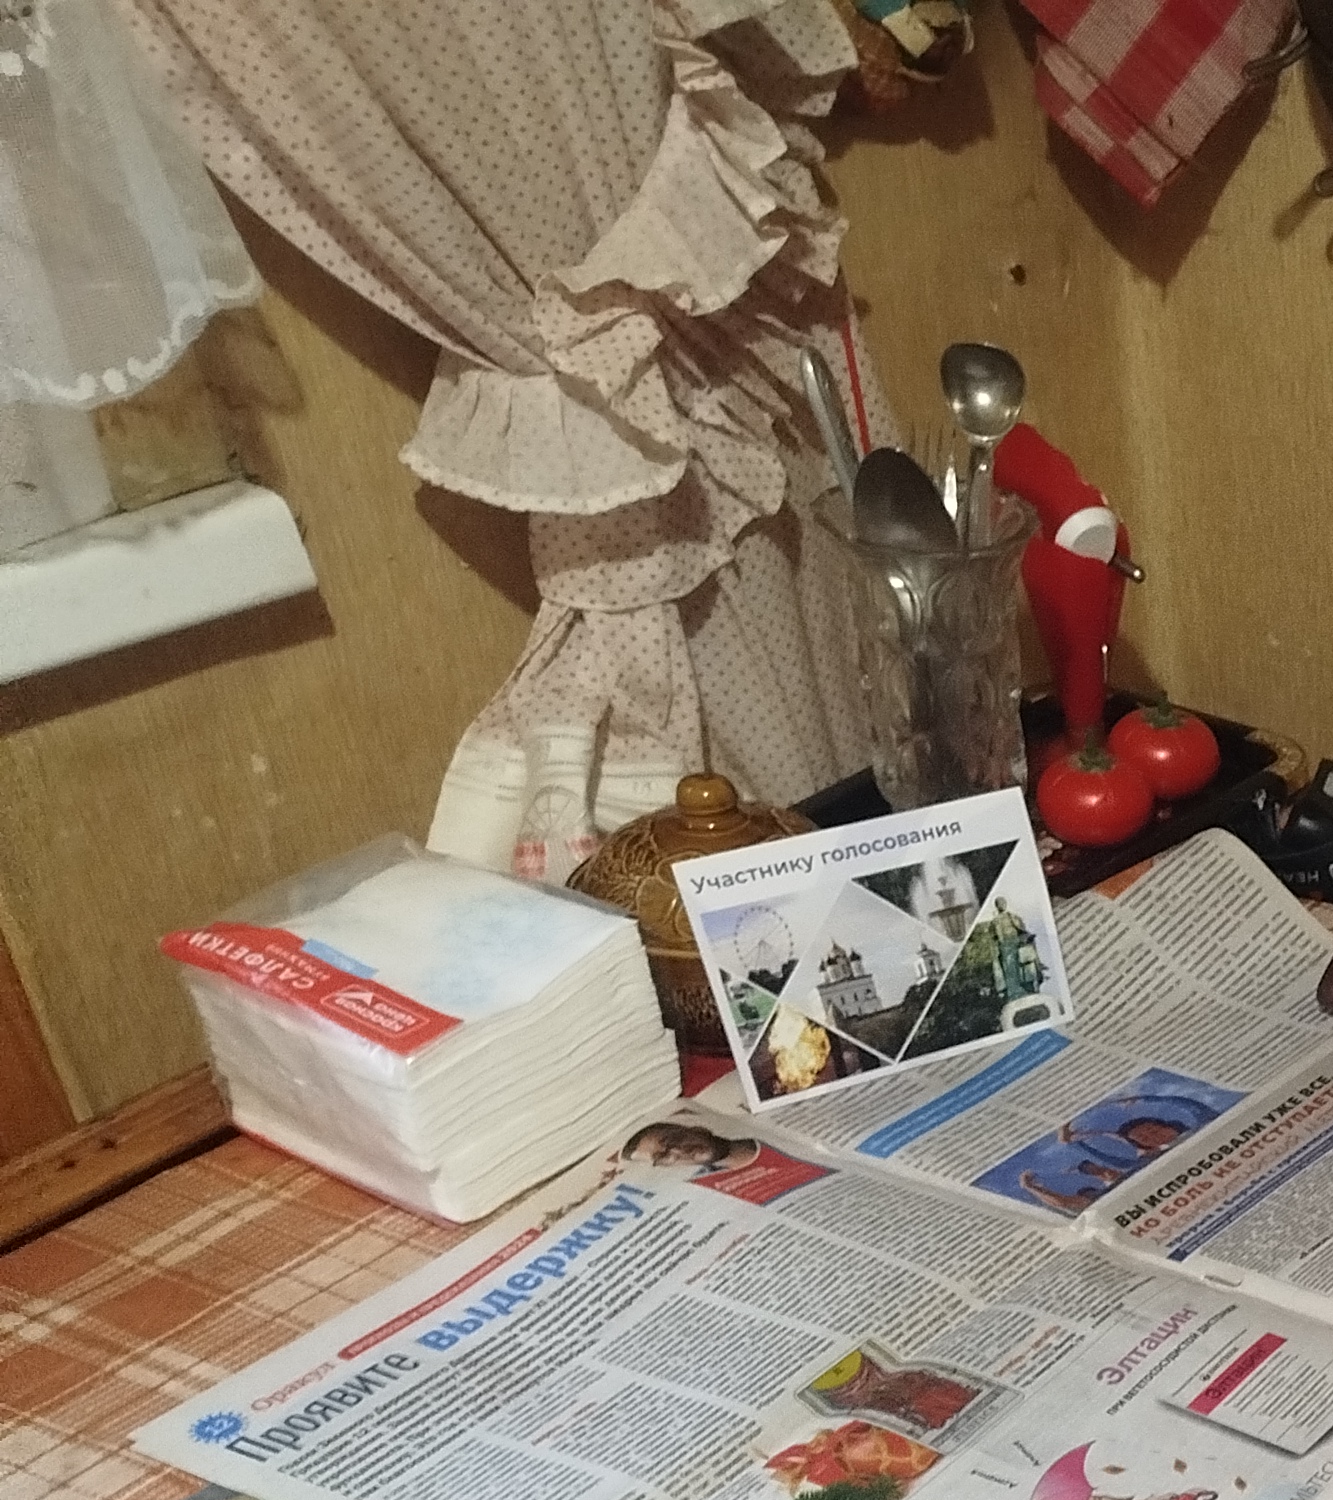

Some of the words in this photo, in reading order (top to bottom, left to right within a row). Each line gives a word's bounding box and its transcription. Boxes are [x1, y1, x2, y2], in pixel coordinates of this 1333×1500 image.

[690, 851, 814, 895] Участнику
[821, 819, 963, 868] голосования
[189, 932, 314, 989] САЛФЕТКИ
[1114, 1204, 1146, 1228] ВЫ
[1144, 1122, 1266, 1207] ИСПРОБОВАЛИ
[1262, 1095, 1302, 1123] УЖЕ
[1129, 1218, 1159, 1239] НО
[1161, 1180, 1214, 1217] БОЛЬ
[1214, 1159, 1241, 1180] НЕ
[226, 1352, 420, 1462] Проявите
[415, 1183, 656, 1351] выдержку!
[1096, 1307, 1198, 1385] Элтацин
